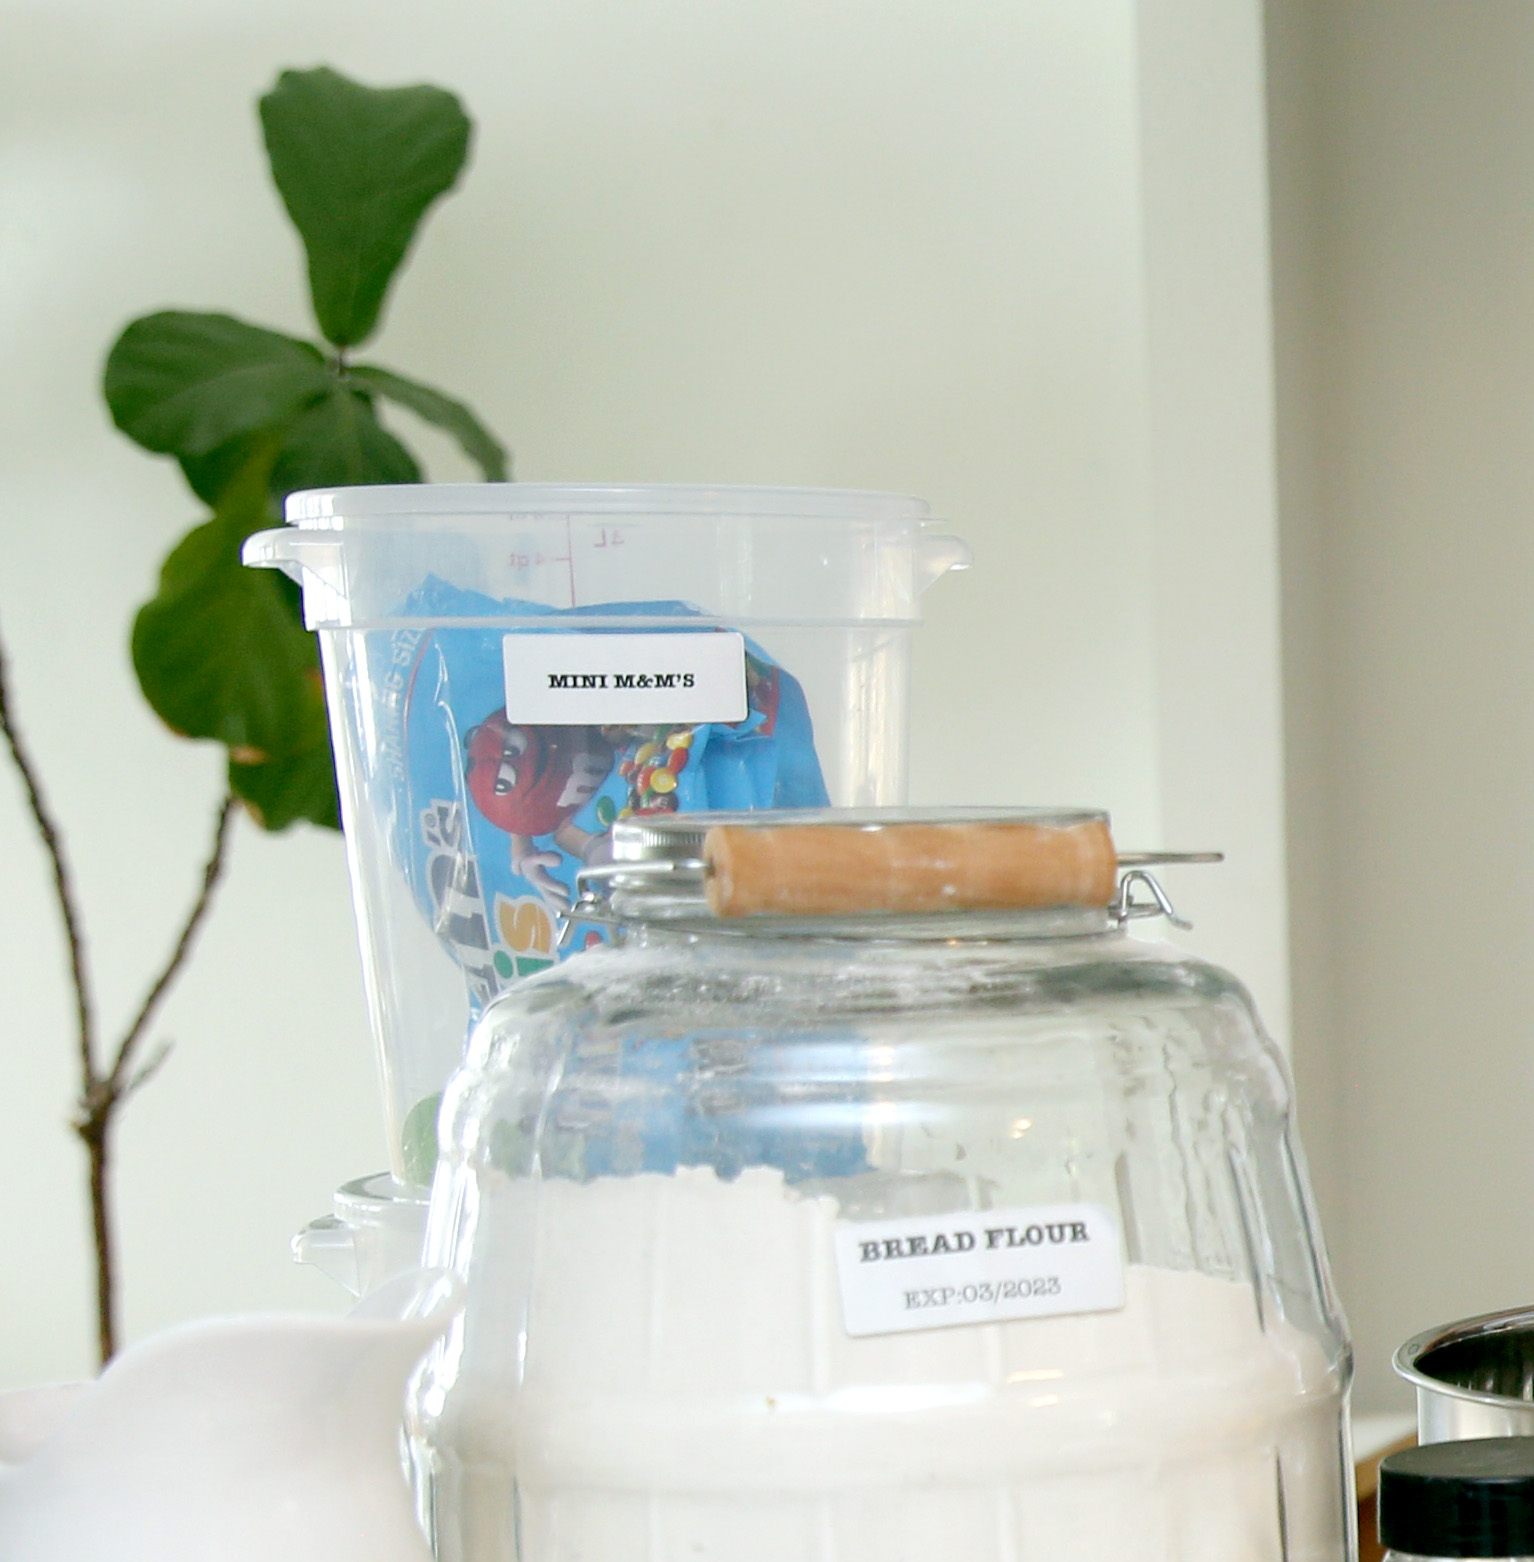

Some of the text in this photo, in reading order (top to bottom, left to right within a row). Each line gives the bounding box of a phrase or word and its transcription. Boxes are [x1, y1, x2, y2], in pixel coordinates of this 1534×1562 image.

[548, 673, 695, 688] MINI M&M'S
[859, 1222, 1090, 1262] BREAD FLOUR
[904, 1277, 1062, 1310] EXP:03/2023
